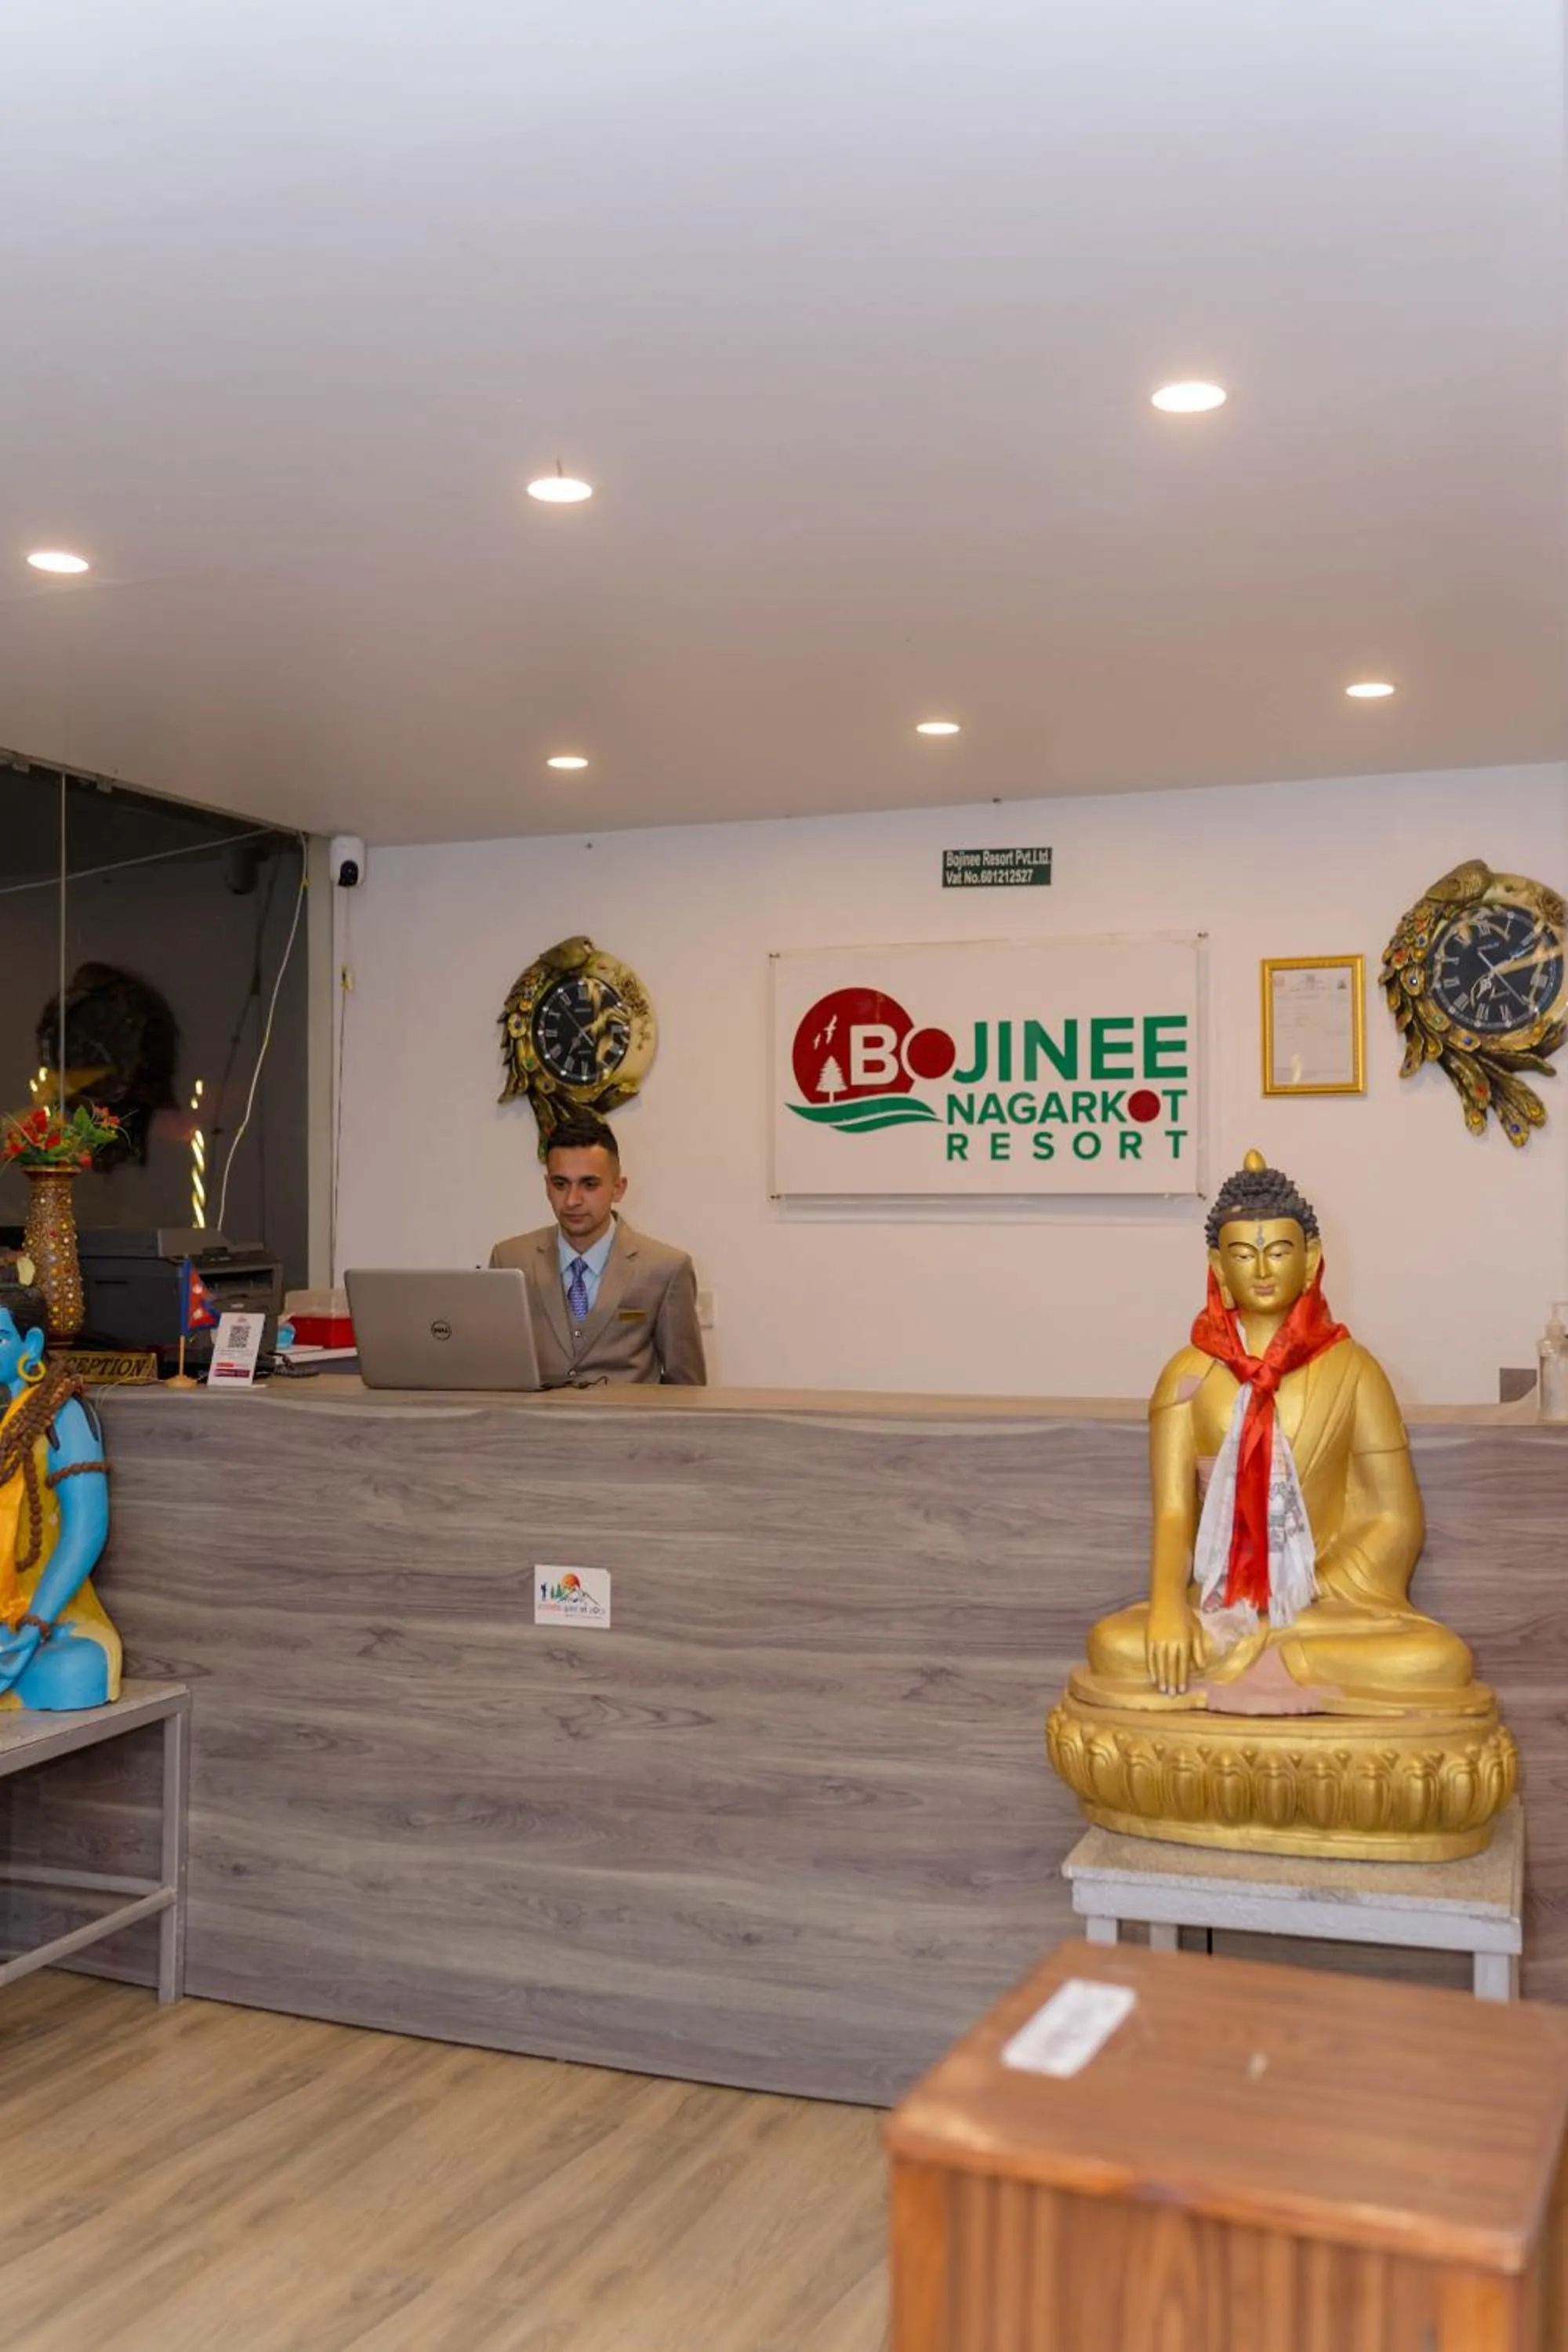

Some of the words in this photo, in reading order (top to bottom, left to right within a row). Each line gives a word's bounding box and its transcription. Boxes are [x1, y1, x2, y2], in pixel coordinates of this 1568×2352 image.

[946, 851, 980, 869] Bojinee
[982, 850, 1014, 866] Resort
[946, 869, 962, 884] Vat
[850, 1015, 1188, 1086] BOJINEE
[946, 1089, 1188, 1125] NAGARKOT
[946, 1130, 1188, 1161] RESORT
